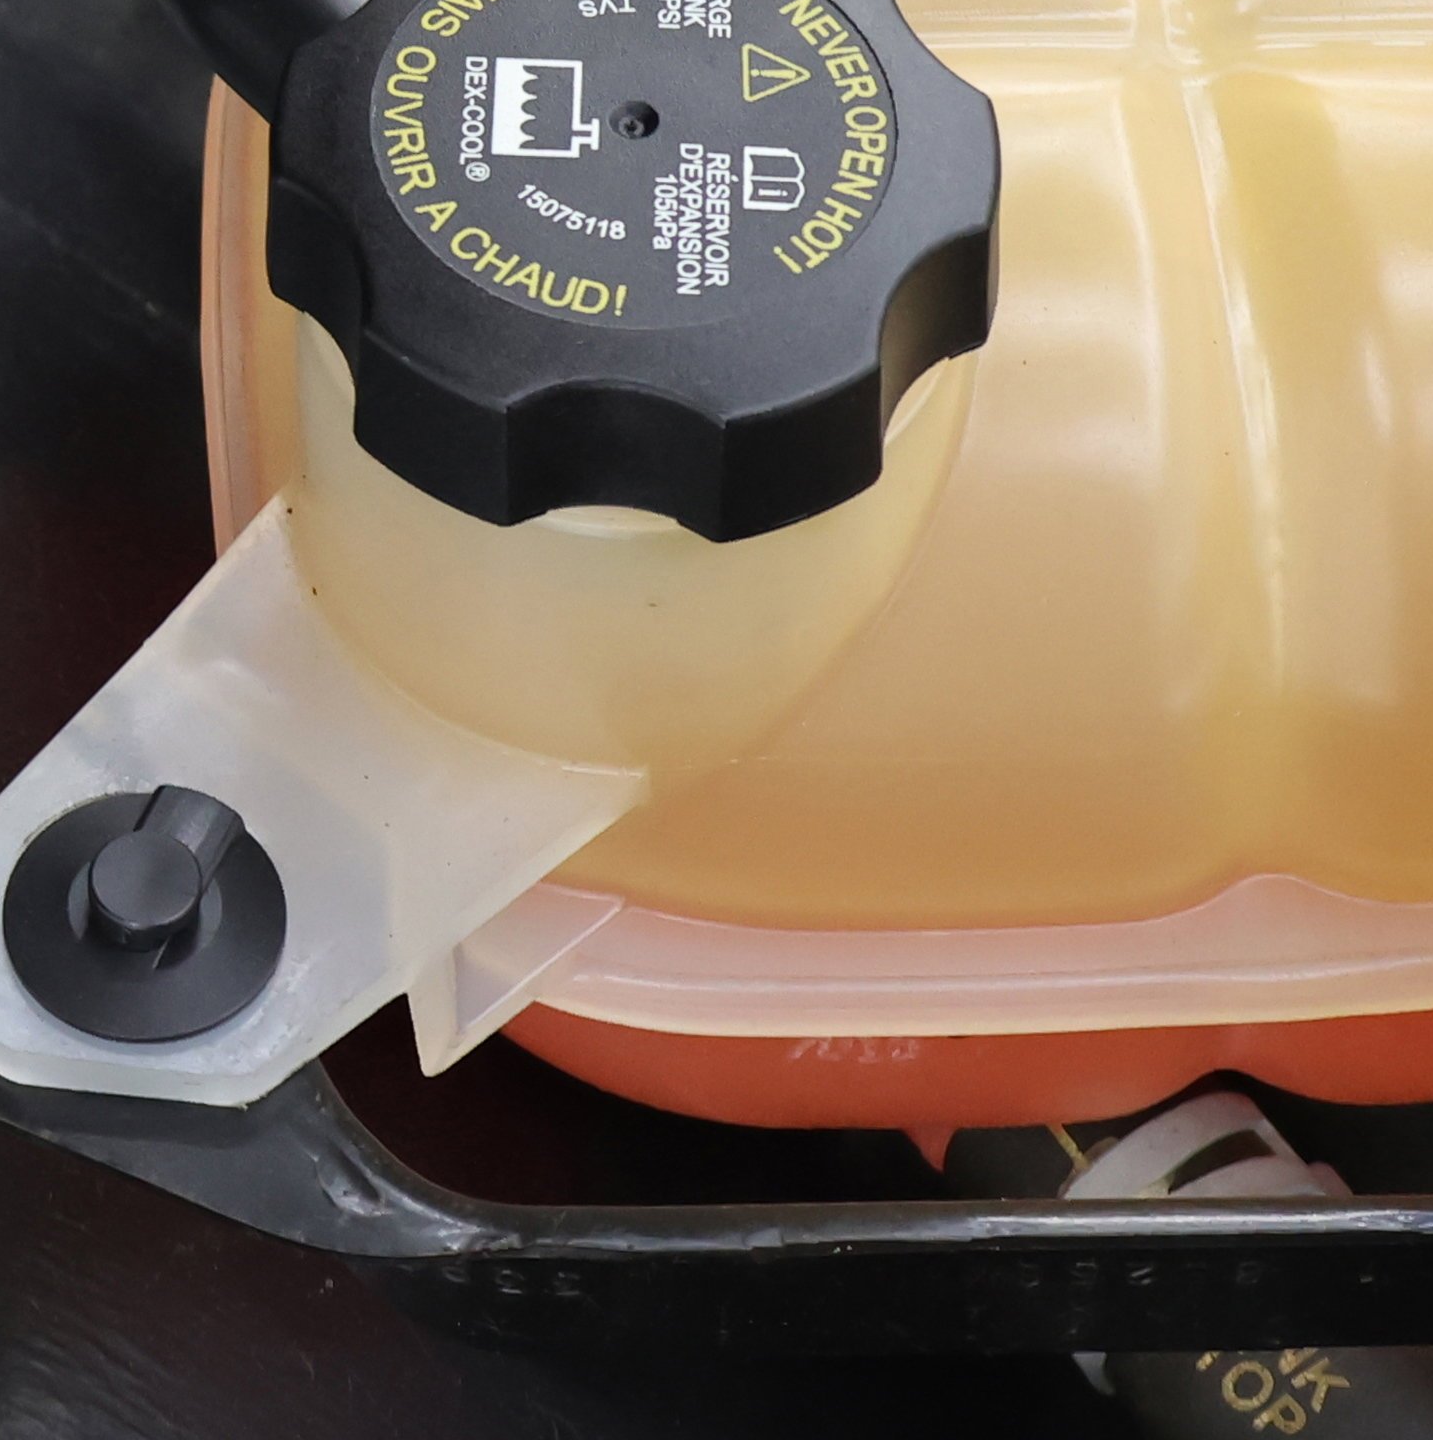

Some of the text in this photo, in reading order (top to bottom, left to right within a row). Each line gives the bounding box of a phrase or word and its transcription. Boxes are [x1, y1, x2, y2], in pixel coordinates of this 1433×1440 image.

[459, 56, 490, 182] DEX-COOL®
[831, 106, 889, 203] OPEN
[384, 44, 438, 195] OUVRIR
[415, 199, 460, 233] A
[449, 226, 628, 317] CHAUD!
[516, 183, 627, 241] 15075118
[652, 174, 679, 251] 105kPa
[677, 143, 701, 295] D'EXPANSION
[704, 152, 738, 288] RÉSERVOIR
[773, 198, 863, 276] HOT!
